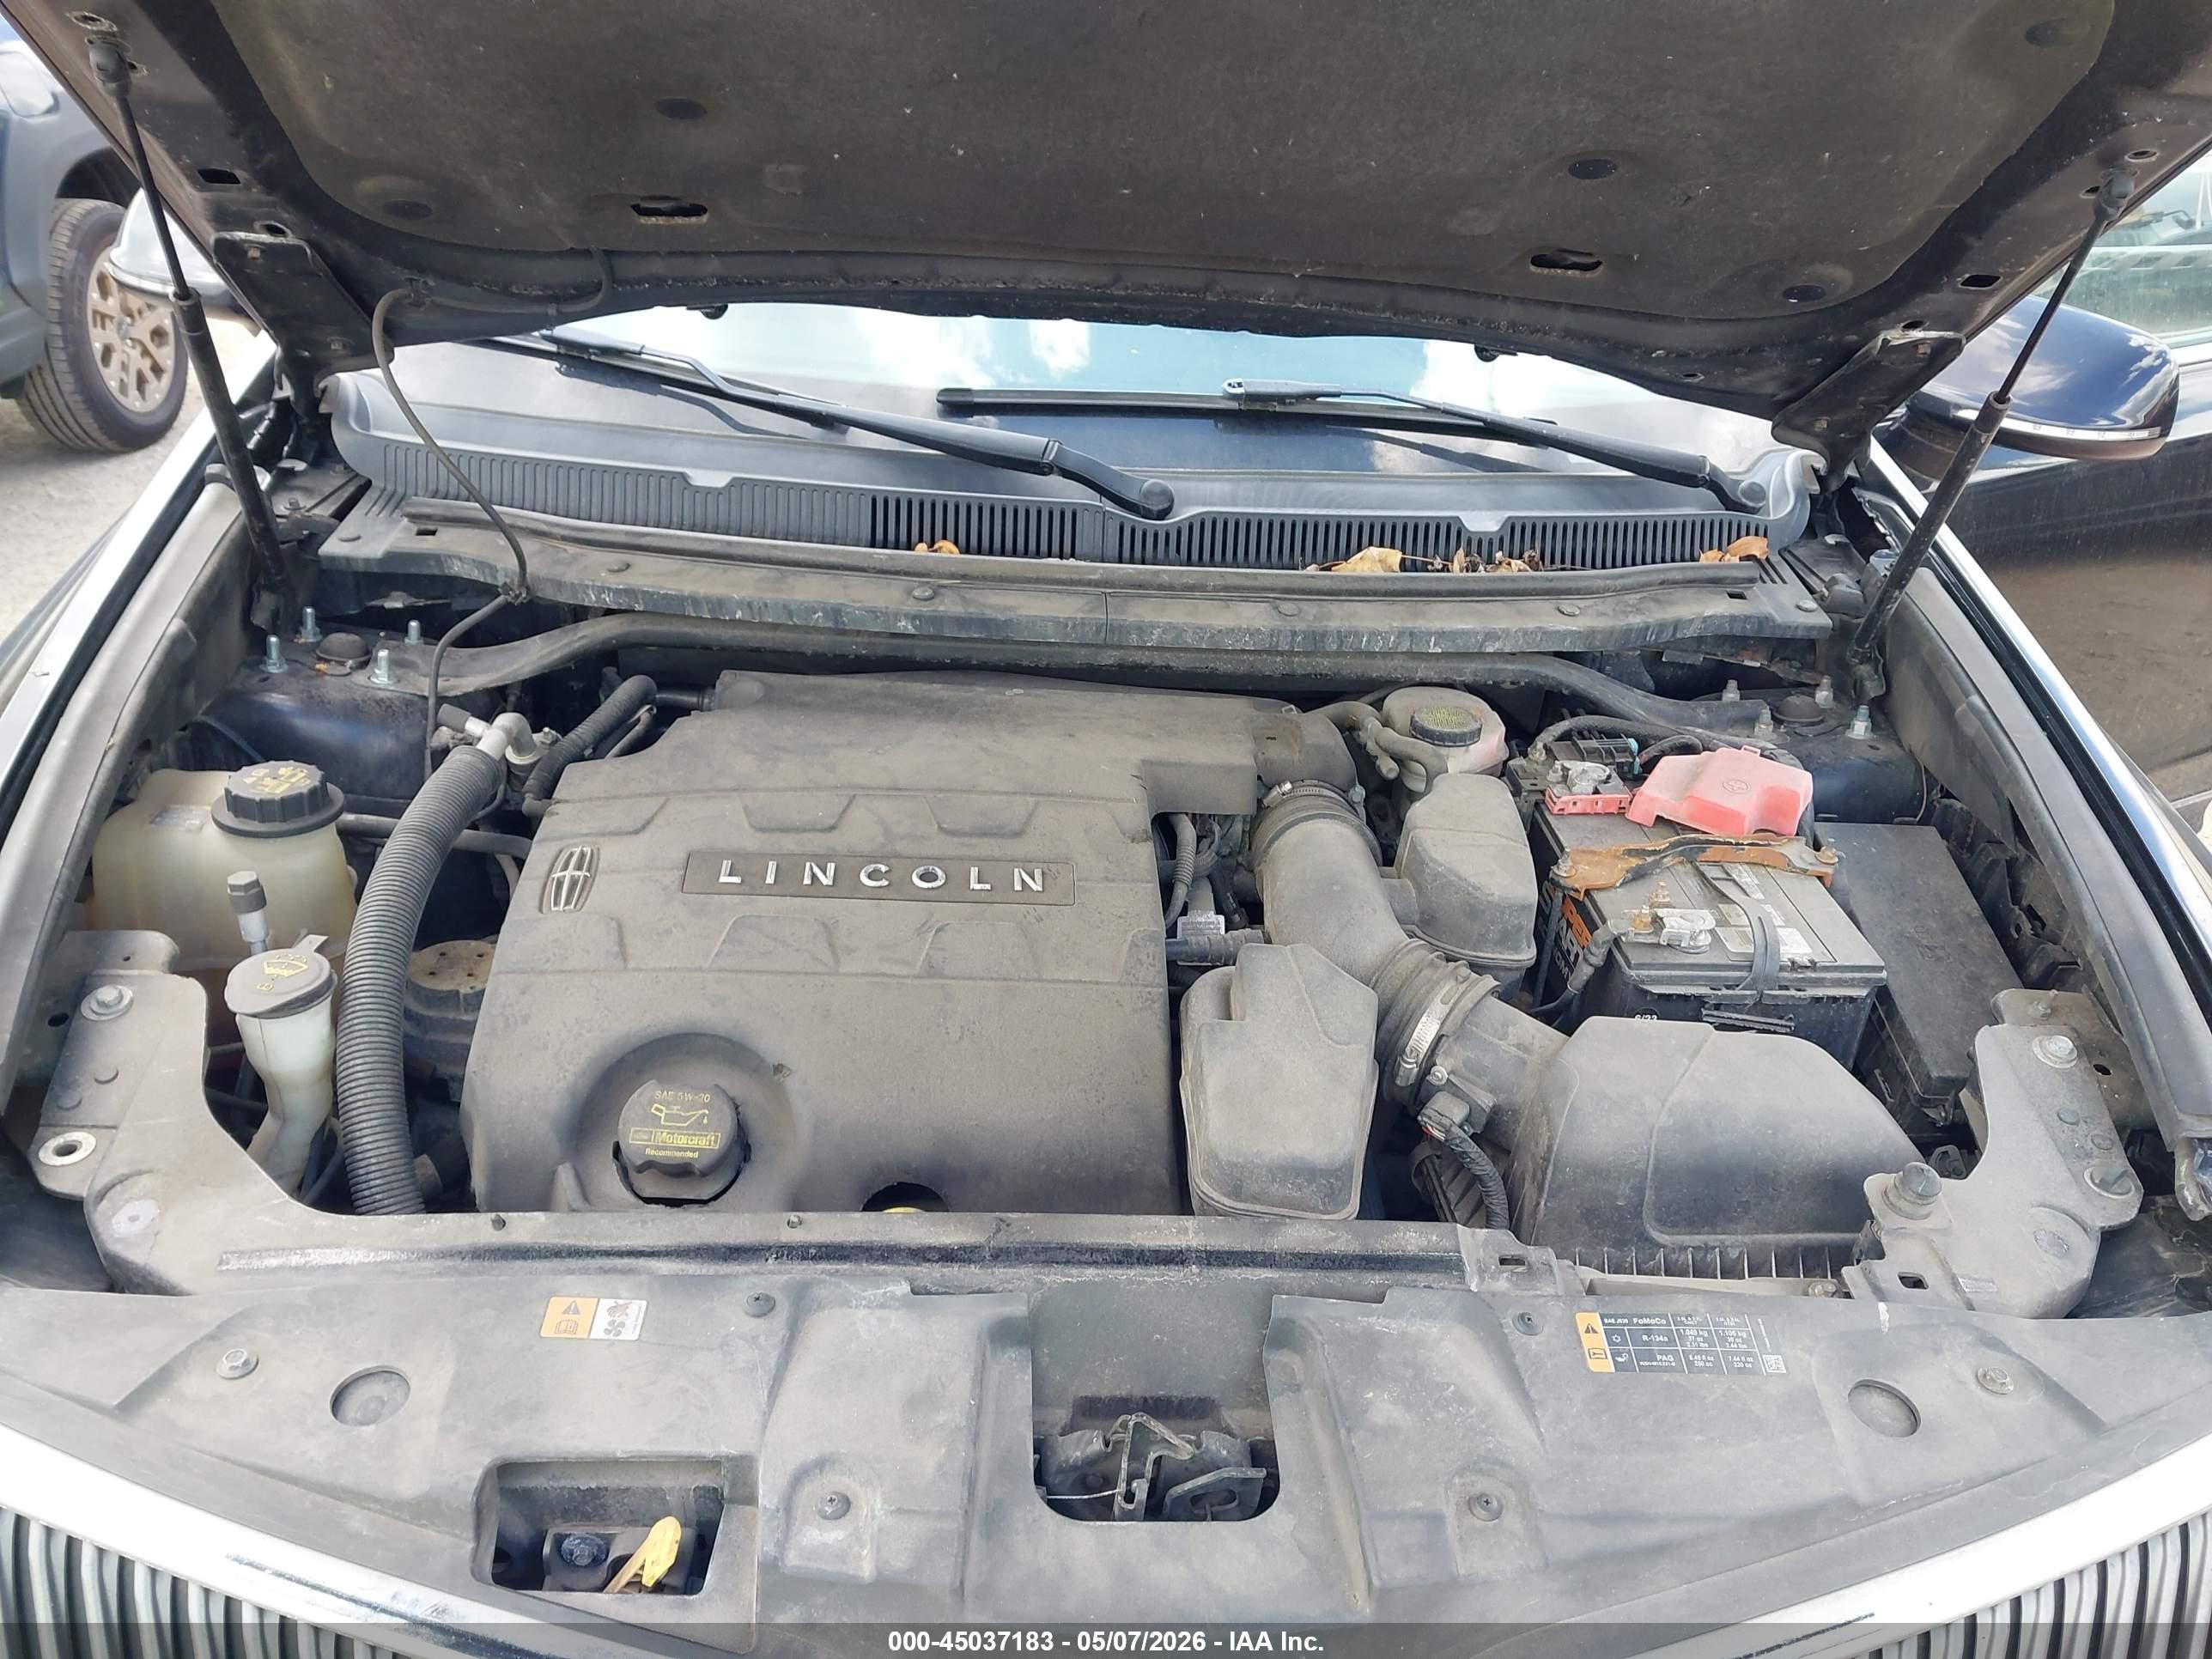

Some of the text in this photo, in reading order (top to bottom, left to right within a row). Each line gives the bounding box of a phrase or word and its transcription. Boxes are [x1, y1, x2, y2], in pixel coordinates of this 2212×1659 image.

[718, 860, 1043, 893] LINCOLN
[654, 1091, 674, 1099] SAE
[654, 1132, 715, 1146] Motorcraft
[645, 1147, 699, 1158] Recommended
